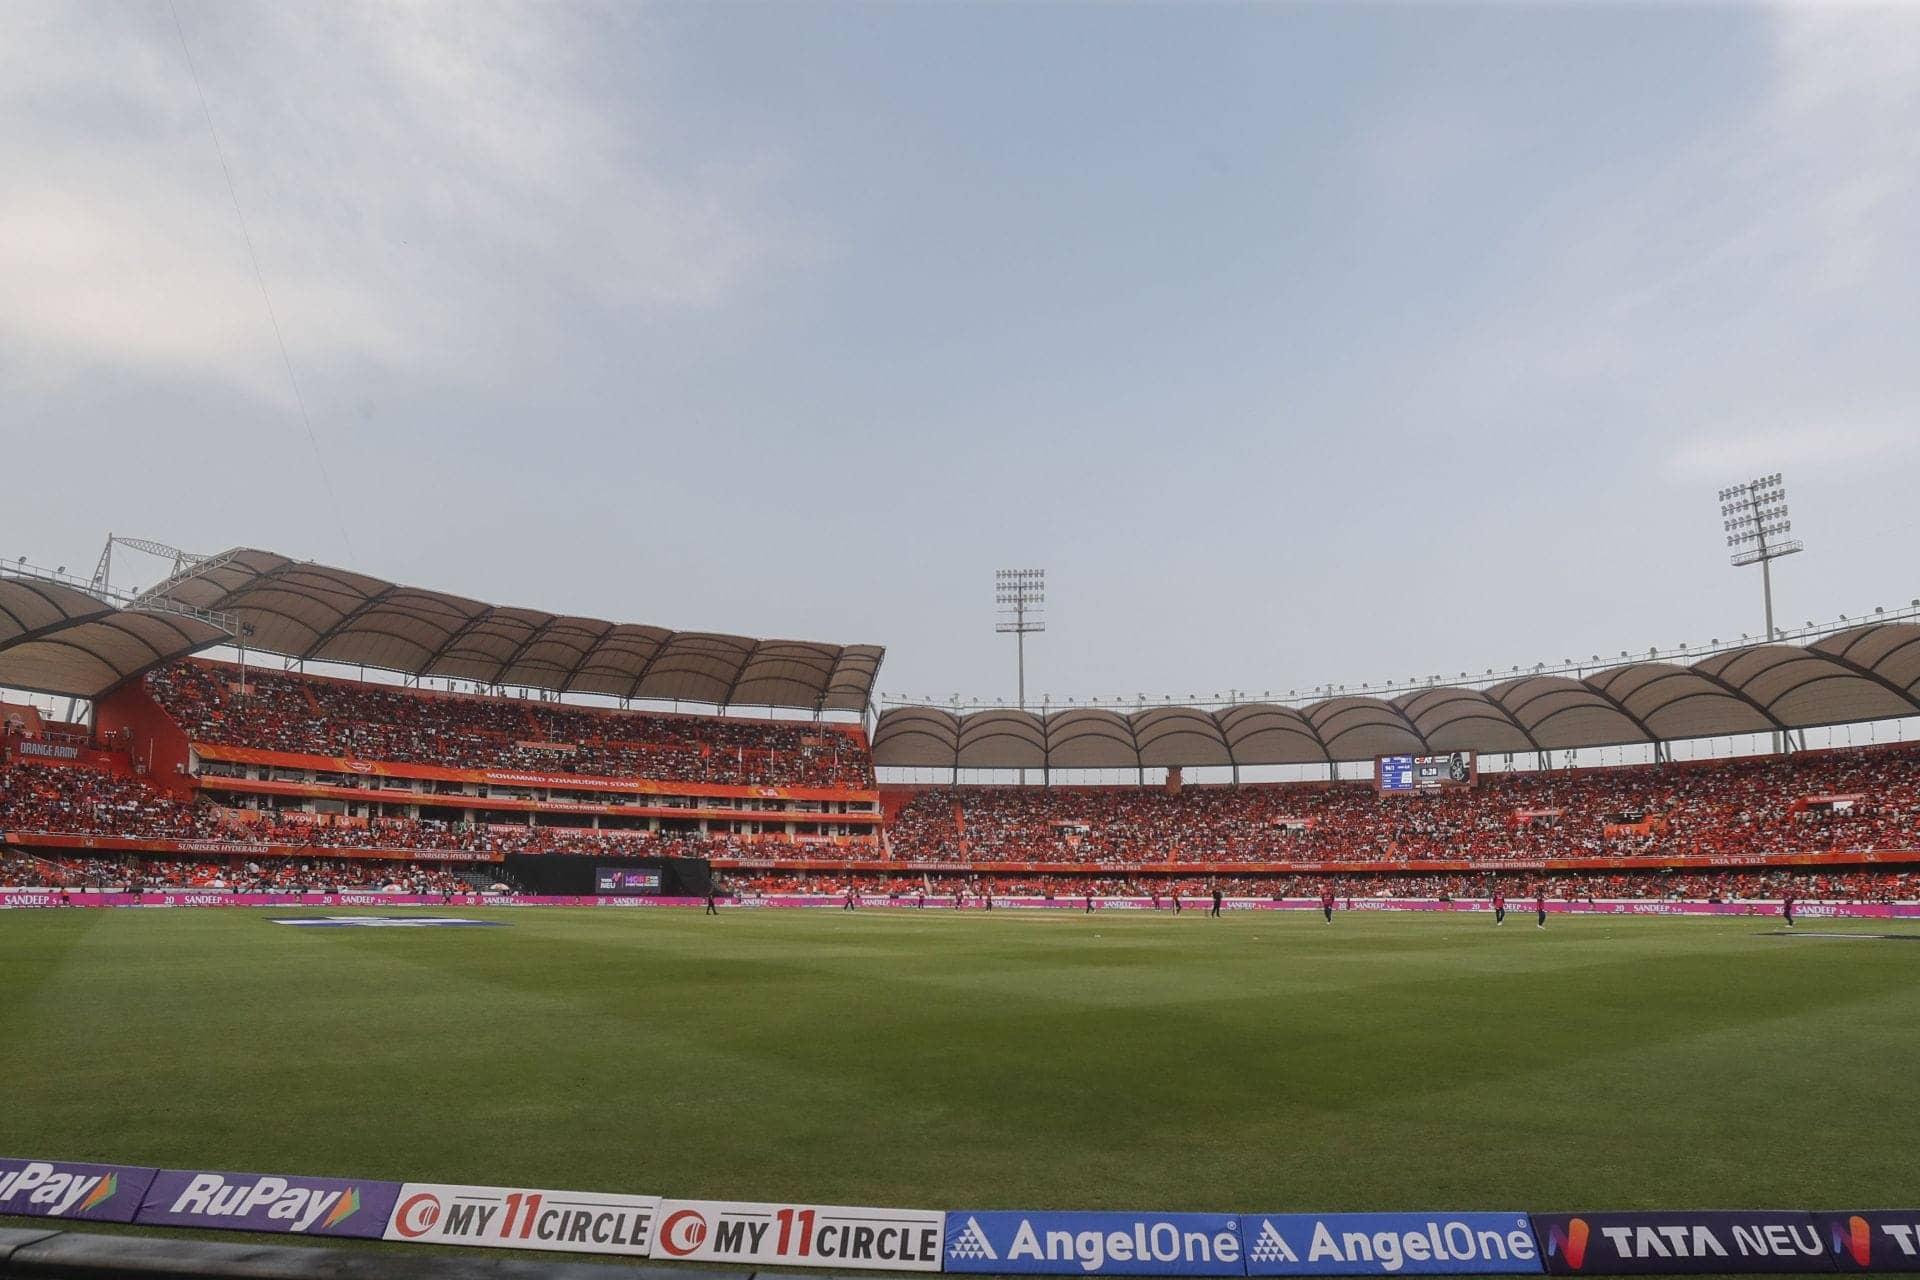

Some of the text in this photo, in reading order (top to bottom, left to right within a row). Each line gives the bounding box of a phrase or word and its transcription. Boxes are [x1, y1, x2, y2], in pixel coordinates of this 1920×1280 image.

[20, 742, 78, 759] ORANGE ARMY
[486, 772, 545, 782] MOHAMMED
[547, 778, 608, 787] AZHARUDDIN
[177, 842, 269, 853] SUNRISERS HYDERABAD
[450, 852, 490, 860] HYDERBAD
[4, 895, 49, 905] SANDEEP
[164, 896, 174, 904] 20
[184, 895, 222, 904] SANDEEP
[322, 896, 332, 904] 20
[341, 896, 375, 904] SANDEEP
[1615, 904, 1625, 912] 20
[1633, 904, 1670, 912] SANDEEP
[1795, 905, 1837, 914] SANDEEP
[169, 1174, 343, 1232] RuPay
[1601, 1224, 1825, 1258] TATA NEU
